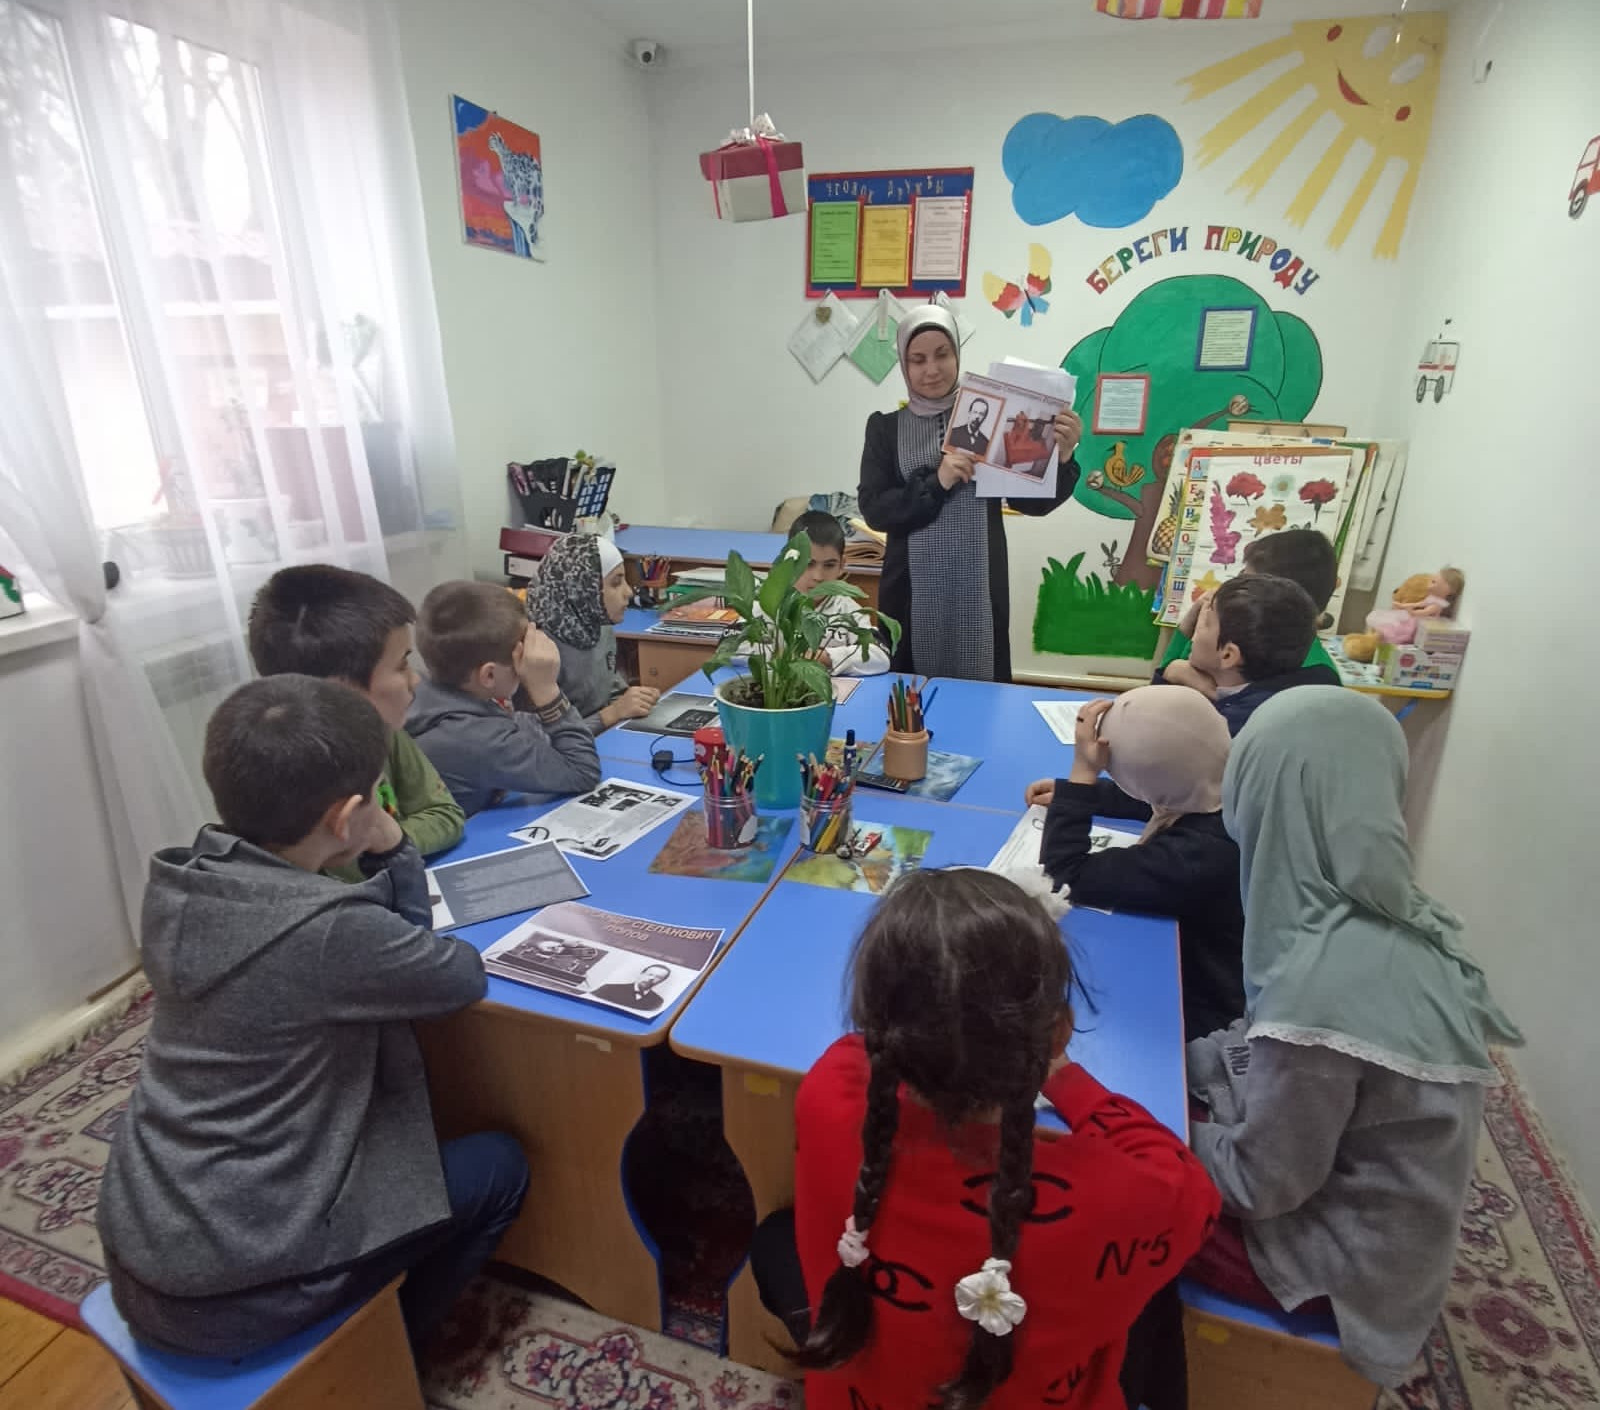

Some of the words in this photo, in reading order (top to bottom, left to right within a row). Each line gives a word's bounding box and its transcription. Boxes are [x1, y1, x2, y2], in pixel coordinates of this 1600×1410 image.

[1086, 226, 1189, 295] БЕРЕГИ
[1204, 225, 1320, 295] ПРИРОДУ
[631, 921, 714, 940] СТЕПАНОВИЧ
